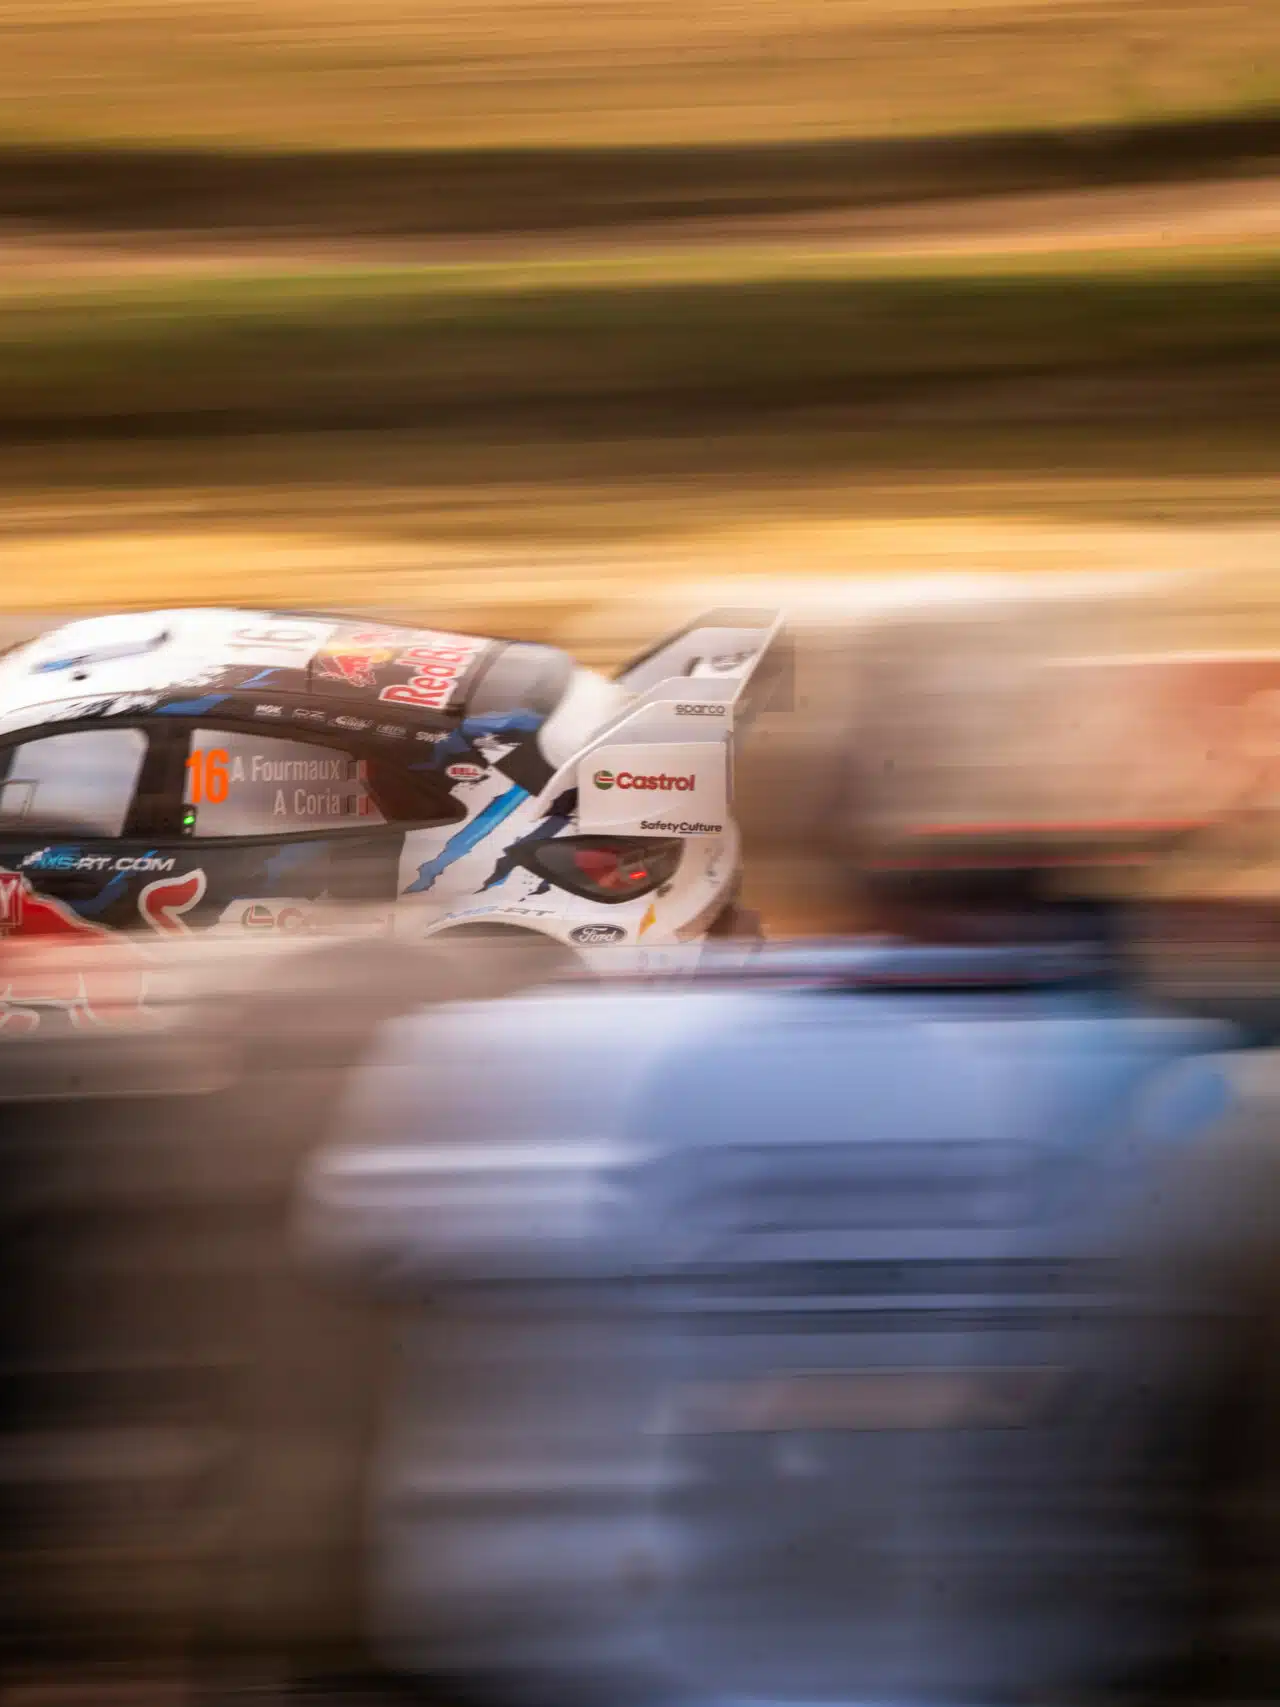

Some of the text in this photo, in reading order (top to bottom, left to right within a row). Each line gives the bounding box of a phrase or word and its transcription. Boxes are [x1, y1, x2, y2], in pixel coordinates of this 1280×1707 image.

[675, 704, 726, 715] sparco
[185, 748, 341, 804] 16 A Fourmaux
[616, 772, 695, 791] Castrol
[273, 788, 341, 816] A Coria
[640, 820, 722, 833] SafetyCulture
[577, 926, 618, 944] Ford
